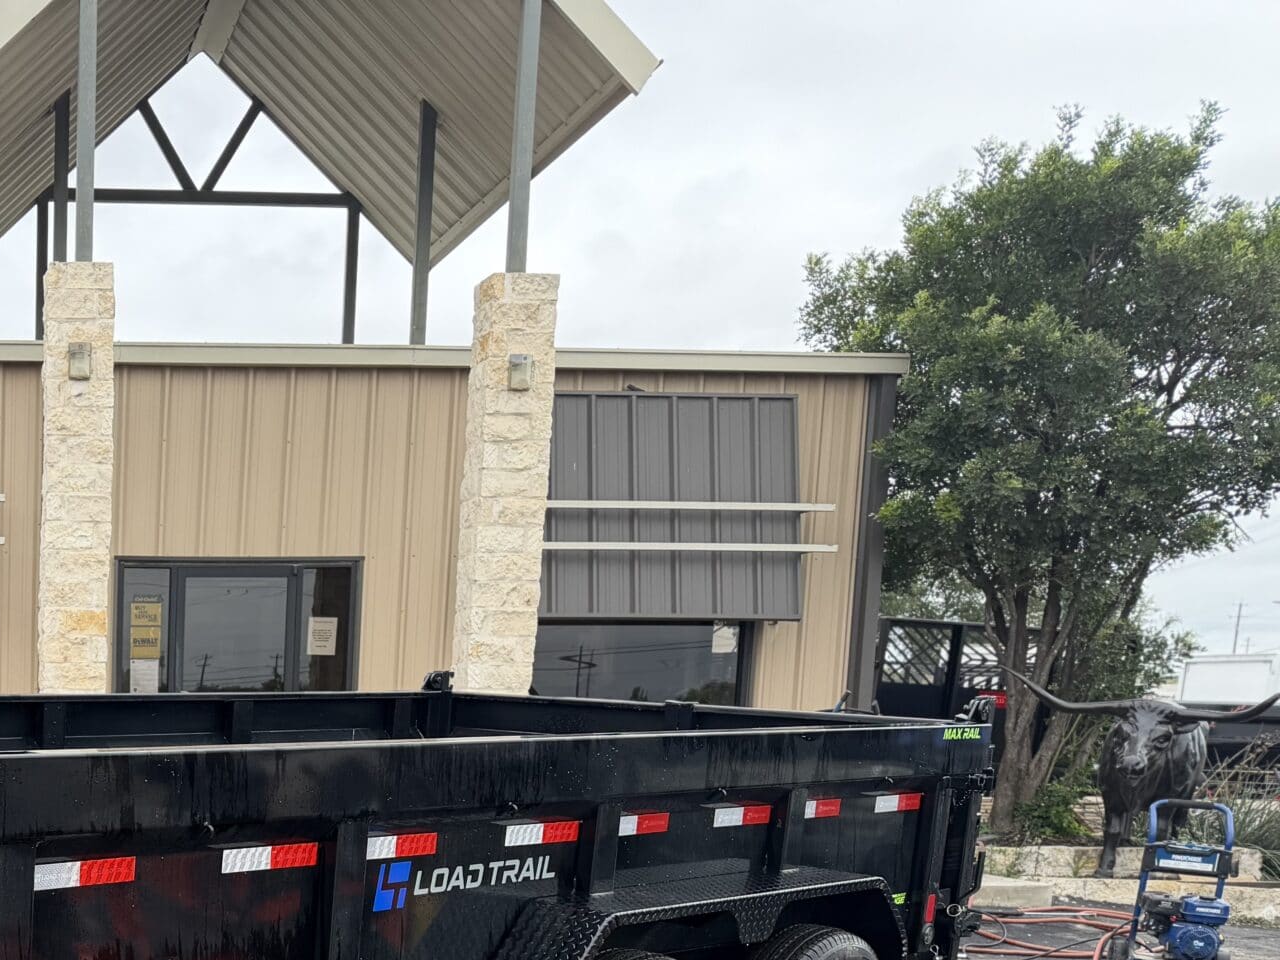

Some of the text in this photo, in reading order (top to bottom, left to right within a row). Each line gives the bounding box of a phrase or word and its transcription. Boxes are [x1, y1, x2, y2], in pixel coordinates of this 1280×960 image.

[943, 727, 981, 740] MAX RAIL
[413, 855, 556, 896] LOAD TRAIL
